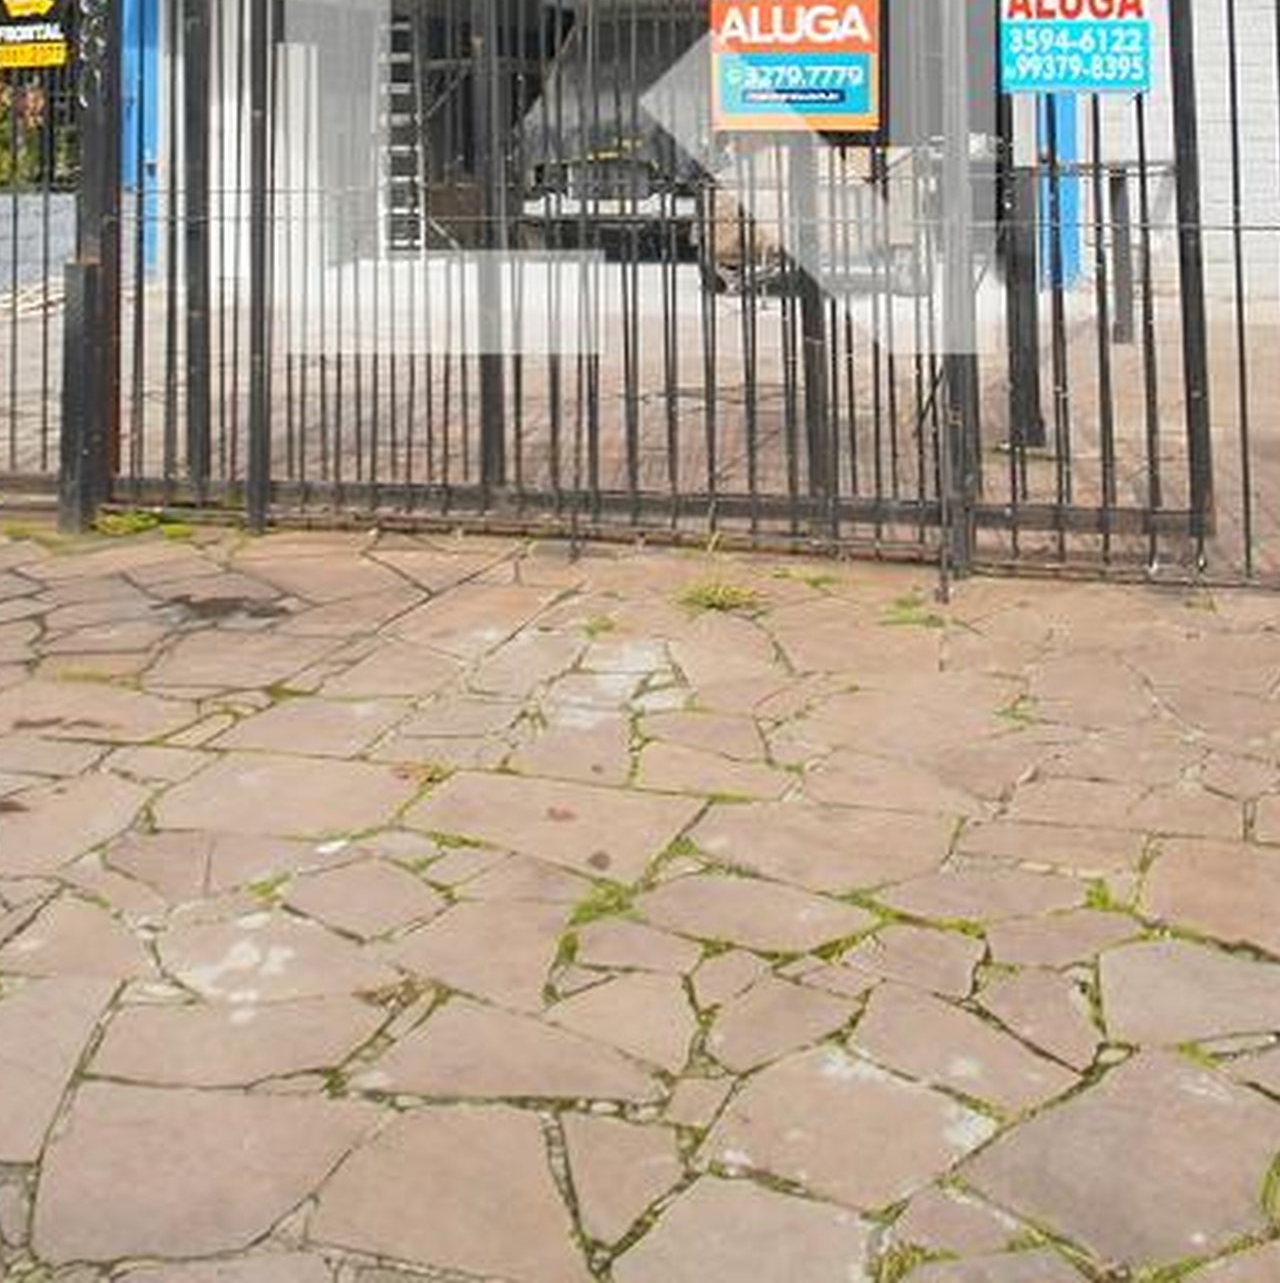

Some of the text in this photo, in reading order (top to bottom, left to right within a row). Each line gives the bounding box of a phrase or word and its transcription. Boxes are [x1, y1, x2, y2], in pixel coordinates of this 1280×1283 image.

[720, 4, 871, 44] ALUGA
[1009, 26, 1142, 53] 3594-6122
[1017, 53, 1144, 81] 99379-8395
